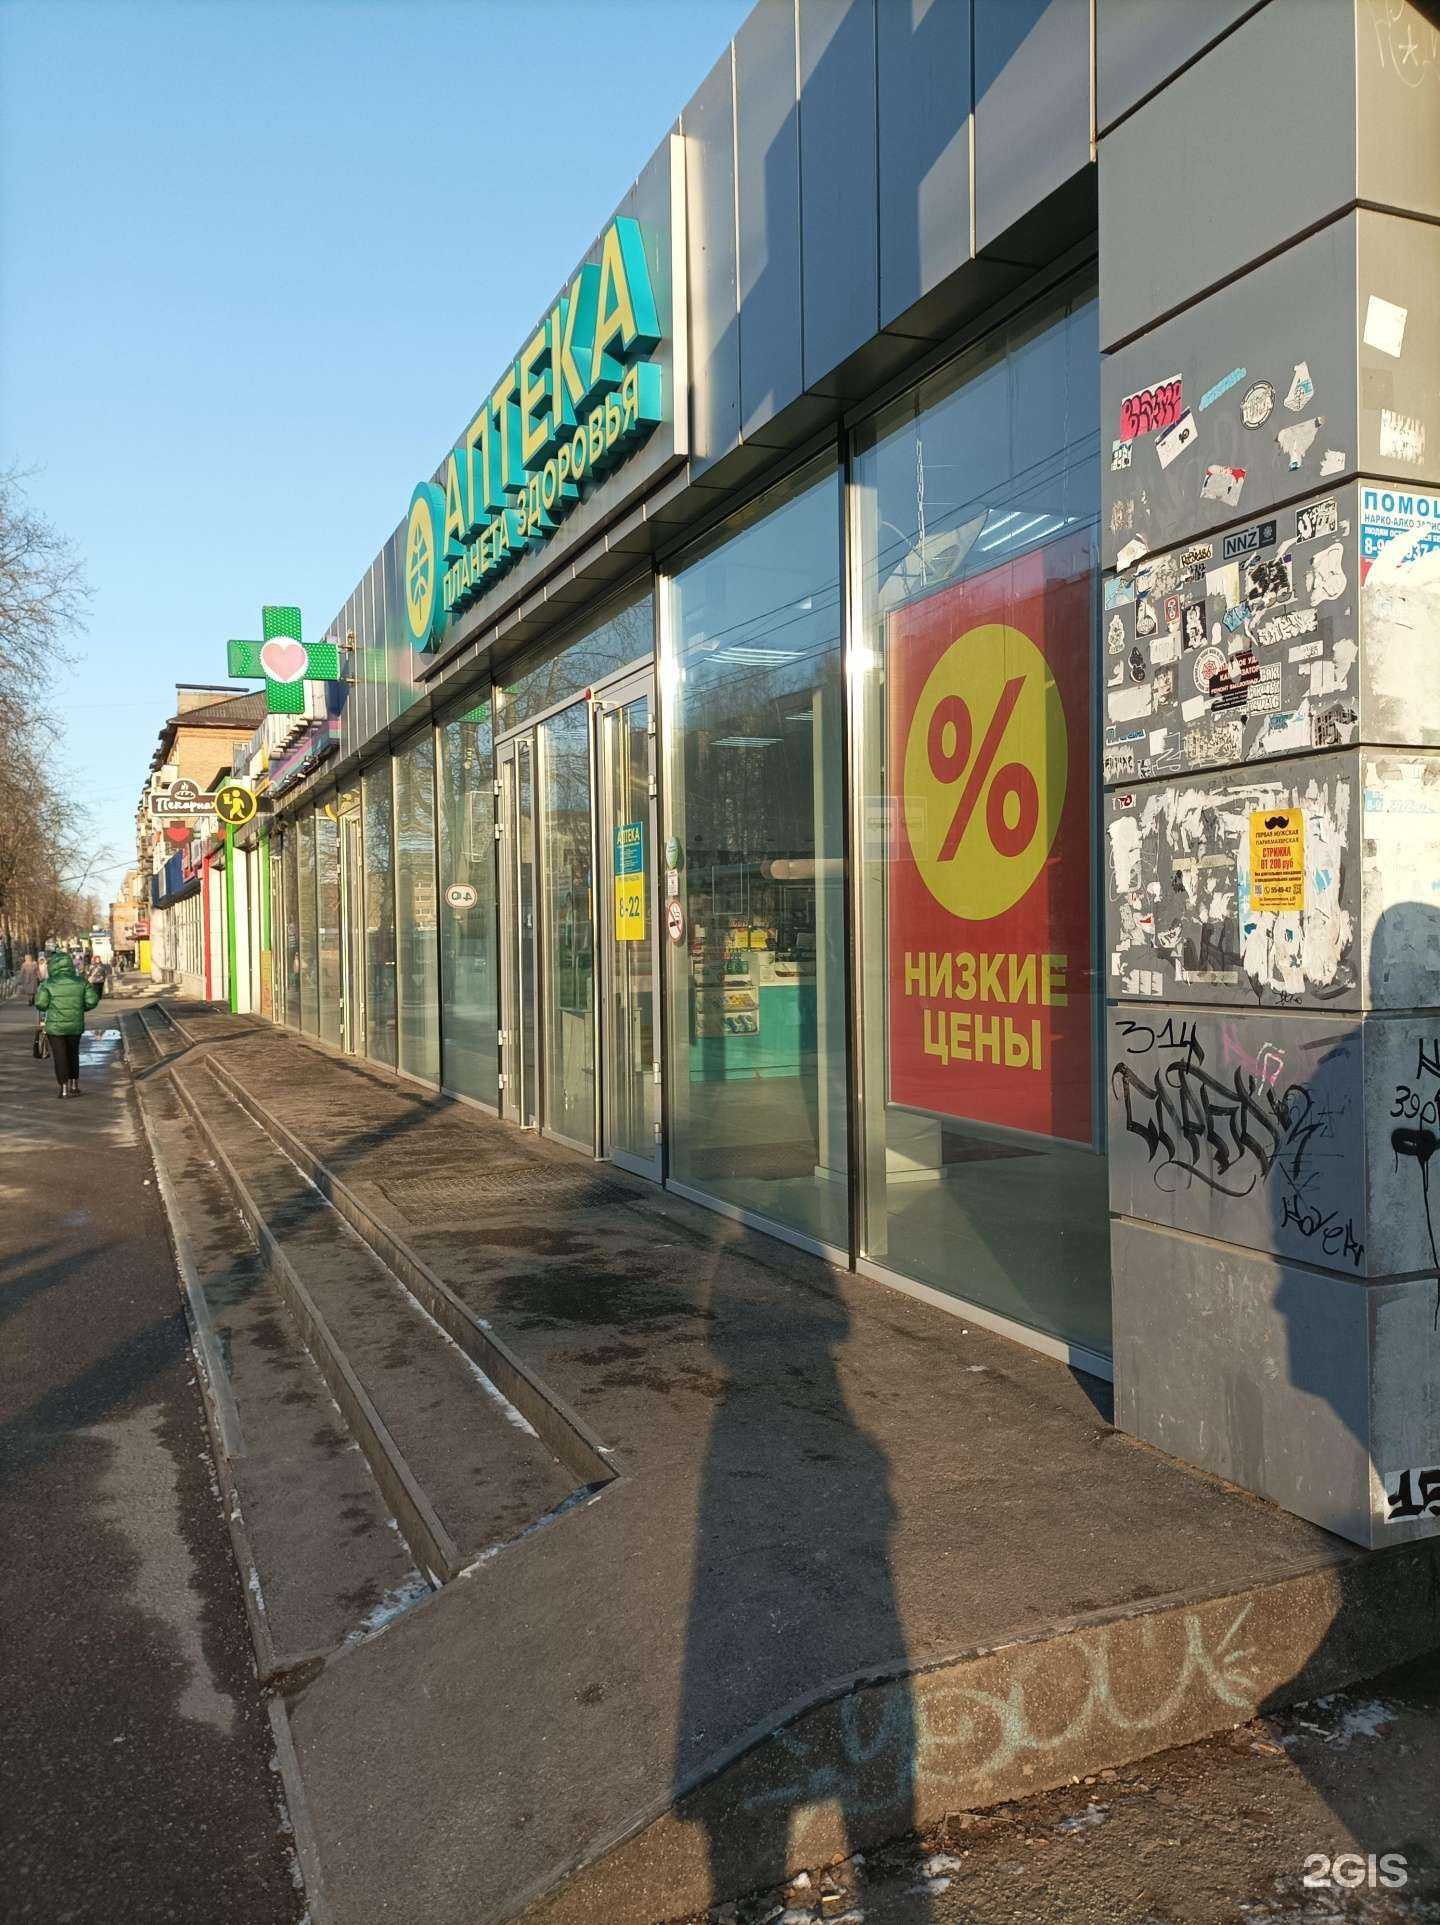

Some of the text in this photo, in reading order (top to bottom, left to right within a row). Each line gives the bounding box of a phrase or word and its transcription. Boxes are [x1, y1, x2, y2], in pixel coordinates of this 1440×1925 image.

[442, 217, 659, 561] АПТЕКА
[443, 363, 657, 609] ПЛАНЕТА ЗДОРОВЬЯ
[904, 951, 1069, 1007] НИЗКИЕ
[922, 1008, 1043, 1071] ЦЕНЫ
